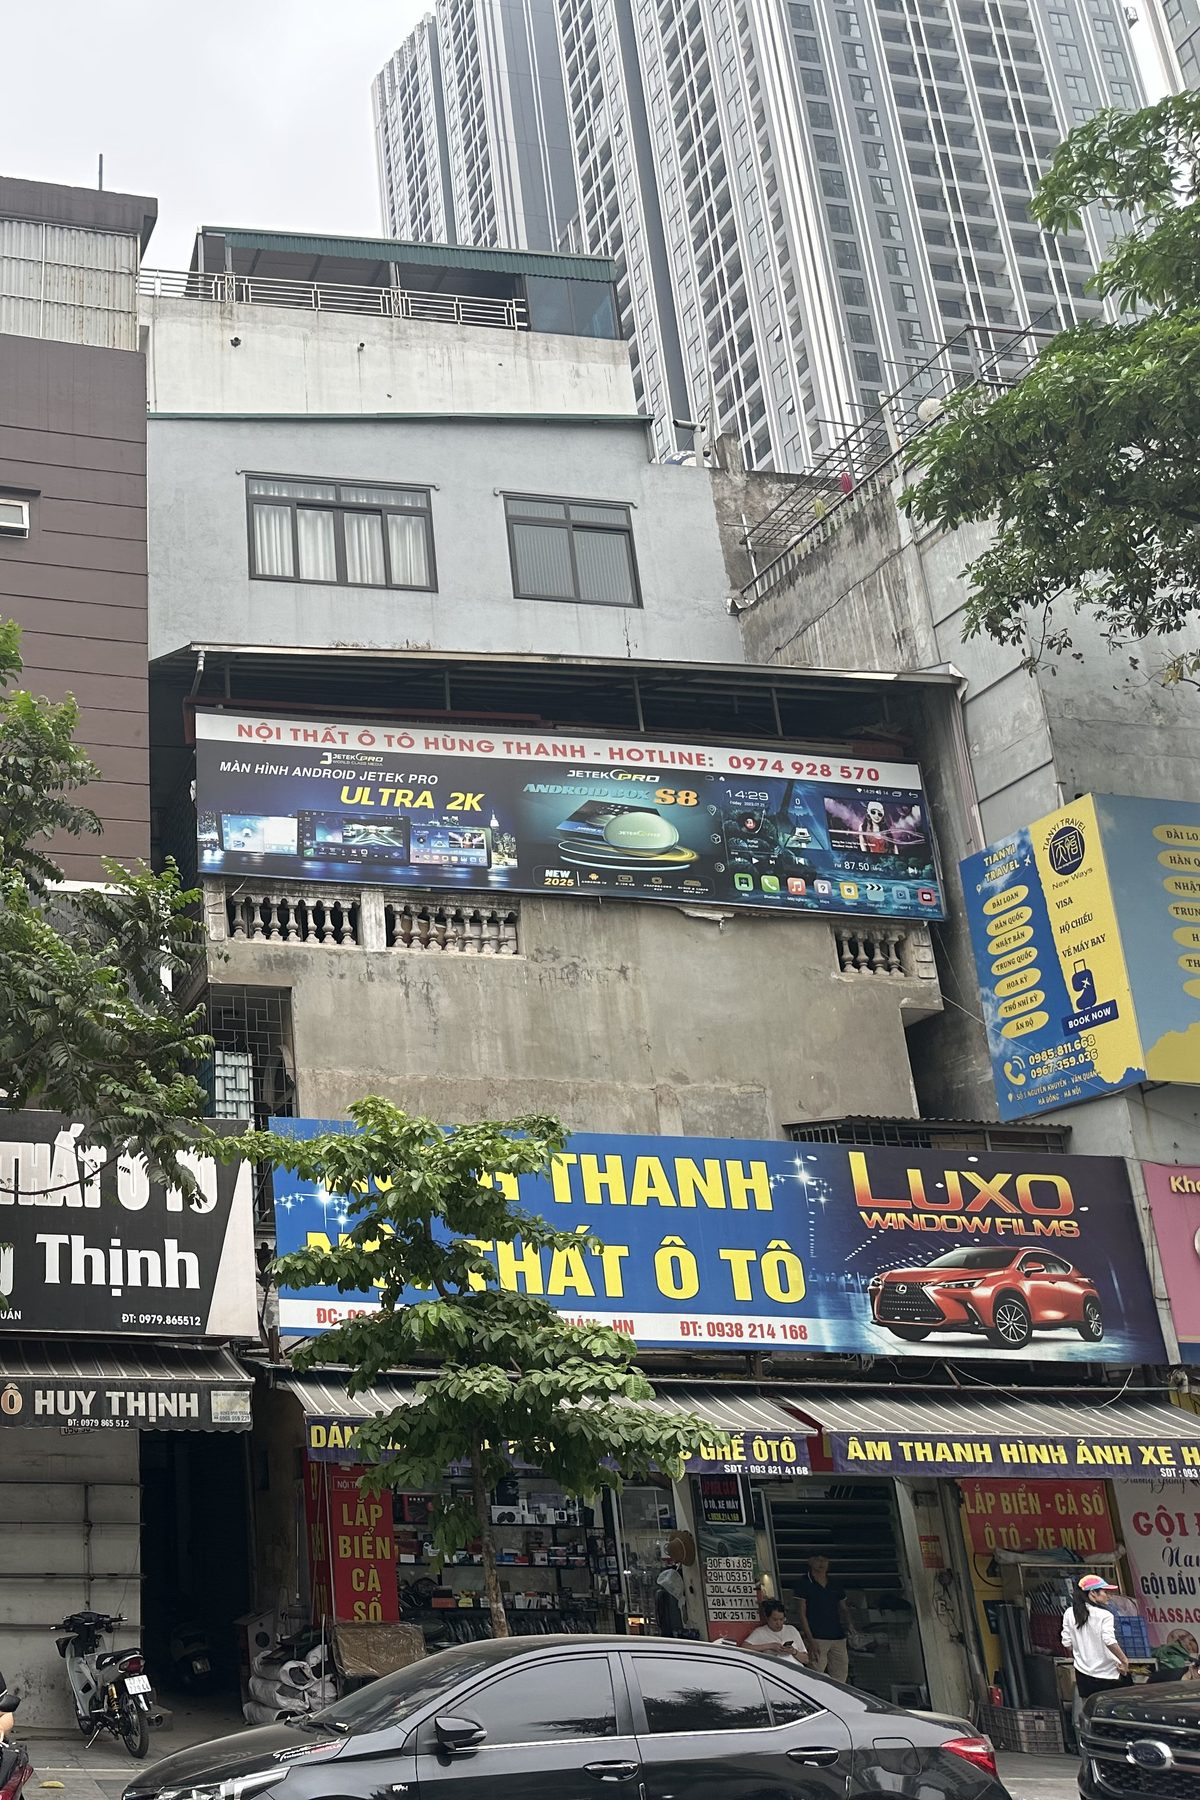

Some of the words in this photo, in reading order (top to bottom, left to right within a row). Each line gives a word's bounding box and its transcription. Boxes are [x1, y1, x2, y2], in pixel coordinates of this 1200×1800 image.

[237, 722, 281, 743] NỘI
[290, 725, 349, 745] THẤT
[357, 729, 376, 746] Ô
[384, 732, 415, 749] TÔ
[424, 734, 495, 753] HÙNG
[502, 741, 586, 758] THANH
[609, 747, 714, 767] HOTLINE:
[728, 756, 785, 773] 0974
[791, 761, 832, 777] 928
[840, 766, 880, 782] 570
[220, 761, 251, 774] MÀN
[254, 761, 289, 776] HÌNH
[292, 766, 356, 780] ANDROID
[359, 771, 405, 783] JETEK
[408, 774, 439, 785] PRO
[566, 769, 611, 779] JETEK
[618, 772, 661, 783] PRO
[340, 785, 434, 809] ULTRA
[446, 791, 485, 812] 2K
[523, 782, 608, 798] ANDROID
[655, 788, 698, 807] S8
[725, 789, 769, 801] 14:29
[1043, 824, 1060, 851] TIANYI
[1060, 818, 1087, 833] TRAVEL
[1166, 829, 1184, 840] ĐÀI
[844, 861, 870, 871] 87.50
[983, 843, 1016, 867] TIANYI
[1169, 854, 1191, 865] HÀN
[543, 877, 575, 887] 2025
[544, 869, 571, 878] NEW
[984, 860, 1020, 883] TRAVEL
[1055, 896, 1074, 910] VISA
[1059, 921, 1071, 934] HỘ
[1071, 912, 1094, 929] CHIẾU
[1061, 946, 1072, 959] VÉ
[1073, 940, 1089, 955] MÁY
[1090, 934, 1106, 947] BAY
[1067, 1015, 1091, 1029] BOOK
[1091, 1007, 1111, 1022] NOW
[1028, 1034, 1096, 1065] 0985.811.668
[1030, 1049, 1098, 1079] 0967.359.036
[550, 1152, 773, 1212] THANH
[848, 1151, 1075, 1217] LUXO
[859, 1211, 992, 1234] WINDOW
[994, 1217, 1081, 1239] FILMS
[35, 1233, 201, 1297] Thịnh
[653, 1234, 700, 1300] Ô
[718, 1238, 807, 1304] TÔ
[121, 1313, 137, 1324] ĐT:
[138, 1314, 201, 1326] 0979.865512
[680, 1320, 703, 1337] ĐT:
[706, 1321, 744, 1338] 0938
[747, 1322, 776, 1339] 214
[780, 1324, 808, 1341] 168
[34, 1390, 96, 1416] HUY
[105, 1391, 199, 1422] THỊNH
[81, 1419, 99, 1428] 0979
[100, 1419, 114, 1428] 865
[115, 1419, 130, 1428] 512
[752, 1435, 797, 1463] ÔTÔ
[847, 1437, 892, 1460] ÂM
[899, 1442, 993, 1463] THANH
[999, 1440, 1068, 1464] HÌNH
[1076, 1439, 1132, 1465] ẢNH
[1138, 1446, 1177, 1465] XE
[750, 1465, 766, 1474] 093
[767, 1465, 782, 1474] 821
[785, 1466, 809, 1475] 4168
[964, 1484, 996, 1514] LẮP
[1000, 1483, 1042, 1515] BIỂN
[1054, 1488, 1079, 1516] CÀ
[1080, 1486, 1105, 1516] SỐ
[984, 1522, 996, 1549] Ô
[999, 1522, 1021, 1549] TÔ
[1034, 1527, 1058, 1549] XE
[1060, 1523, 1098, 1550] MÁY
[1132, 1505, 1189, 1544] GỘI
[338, 1526, 391, 1560] BIỂN
[351, 1564, 382, 1593] CÀ
[1140, 1573, 1166, 1599] GỘI
[1167, 1570, 1196, 1596] ĐẦU
[353, 1594, 383, 1623] SỐ
